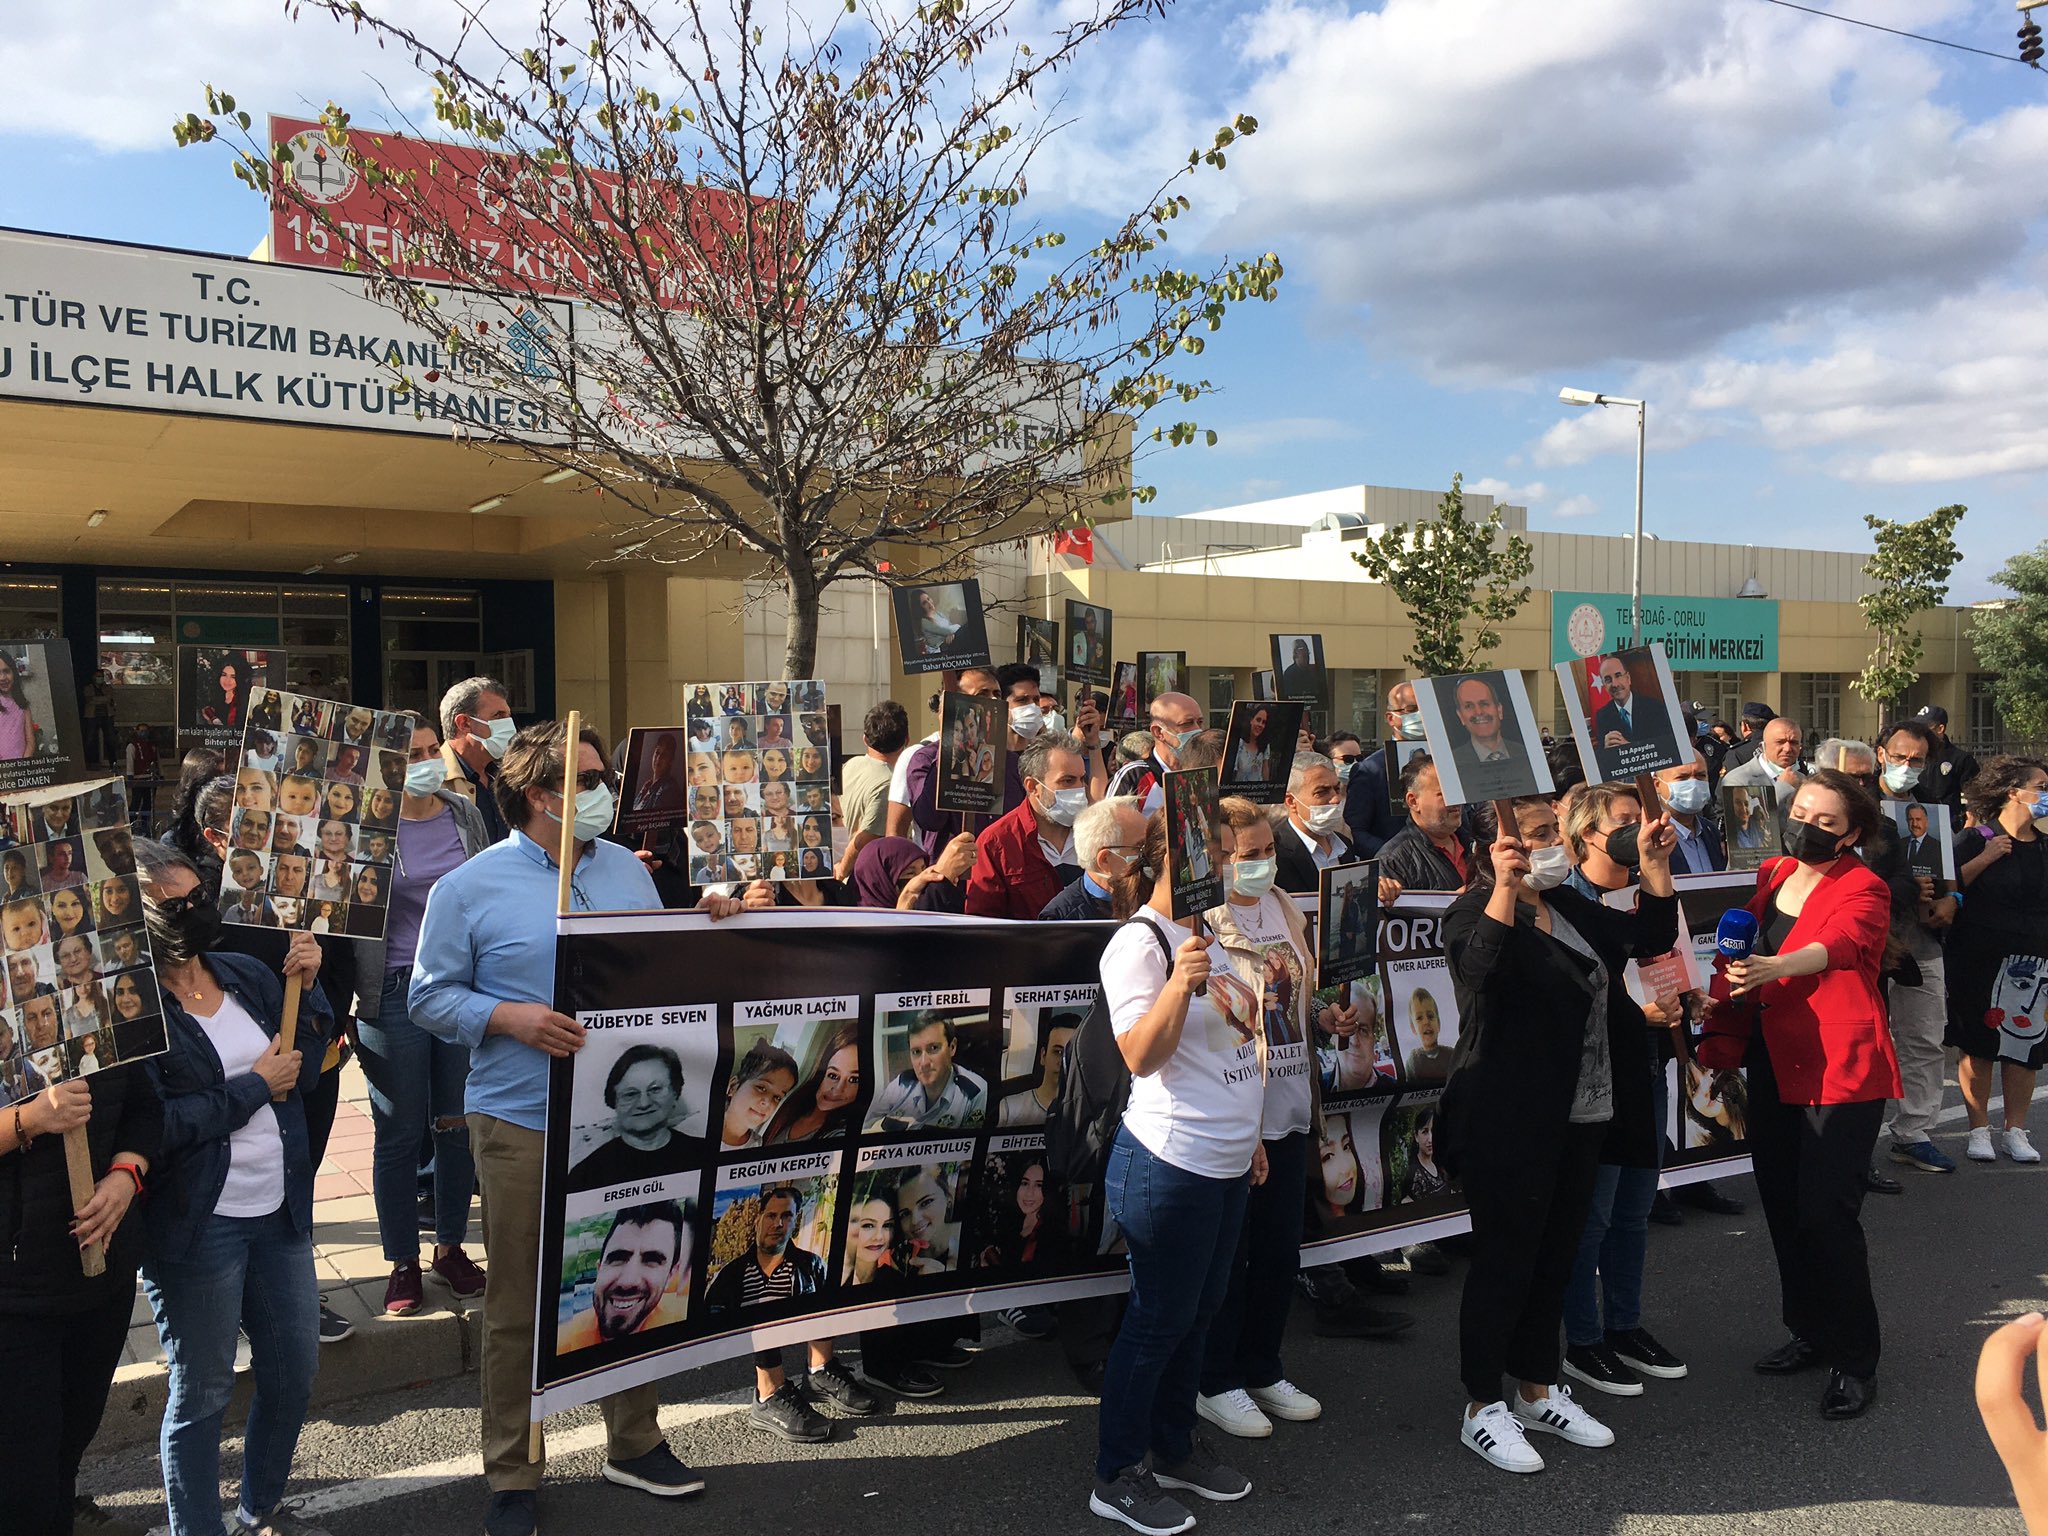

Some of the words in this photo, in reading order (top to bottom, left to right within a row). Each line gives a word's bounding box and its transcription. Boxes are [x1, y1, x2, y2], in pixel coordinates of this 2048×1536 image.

[287, 214, 330, 254] 15
[192, 272, 260, 306] T.C.
[0, 290, 86, 330] TÜR
[98, 304, 149, 337] VE
[159, 313, 297, 354] TURİZM
[31, 341, 131, 394] İLÇE
[147, 361, 264, 403] HALK
[1673, 610, 1706, 628] ÇORLU
[1708, 633, 1764, 661] MERKEZİ
[922, 662, 941, 671] Bahar
[942, 658, 972, 669] KOÇMAN
[204, 738, 227, 746] Bihter
[1618, 748, 1628, 756] İsa
[1629, 743, 1655, 755] Apaydın
[1610, 767, 1629, 777] TCDD
[1629, 762, 1648, 773] Genel
[1648, 757, 1673, 768] Müdürü
[1620, 751, 1658, 765] 08.07.2018
[17, 775, 51, 788] DİKMEN
[1392, 960, 1416, 973] ÖMER
[898, 992, 932, 1008] SEYFİ
[935, 990, 970, 1006] ERBİL
[1014, 989, 1061, 1004] SERHAT
[745, 1001, 803, 1018] YAĞMUR
[806, 998, 846, 1016] LAÇİN
[583, 1013, 653, 1030] ZÜBEYDE
[661, 1009, 707, 1025] SEVEN
[861, 1147, 903, 1162] DERYA
[906, 1140, 972, 1158] KURTULUŞ
[1001, 1136, 1046, 1149] BİHTER
[729, 1162, 777, 1180] ERGÜN
[780, 1154, 831, 1174] KERPİÇ
[603, 1184, 640, 1203] ERSEN
[642, 1180, 665, 1195] GÜL
